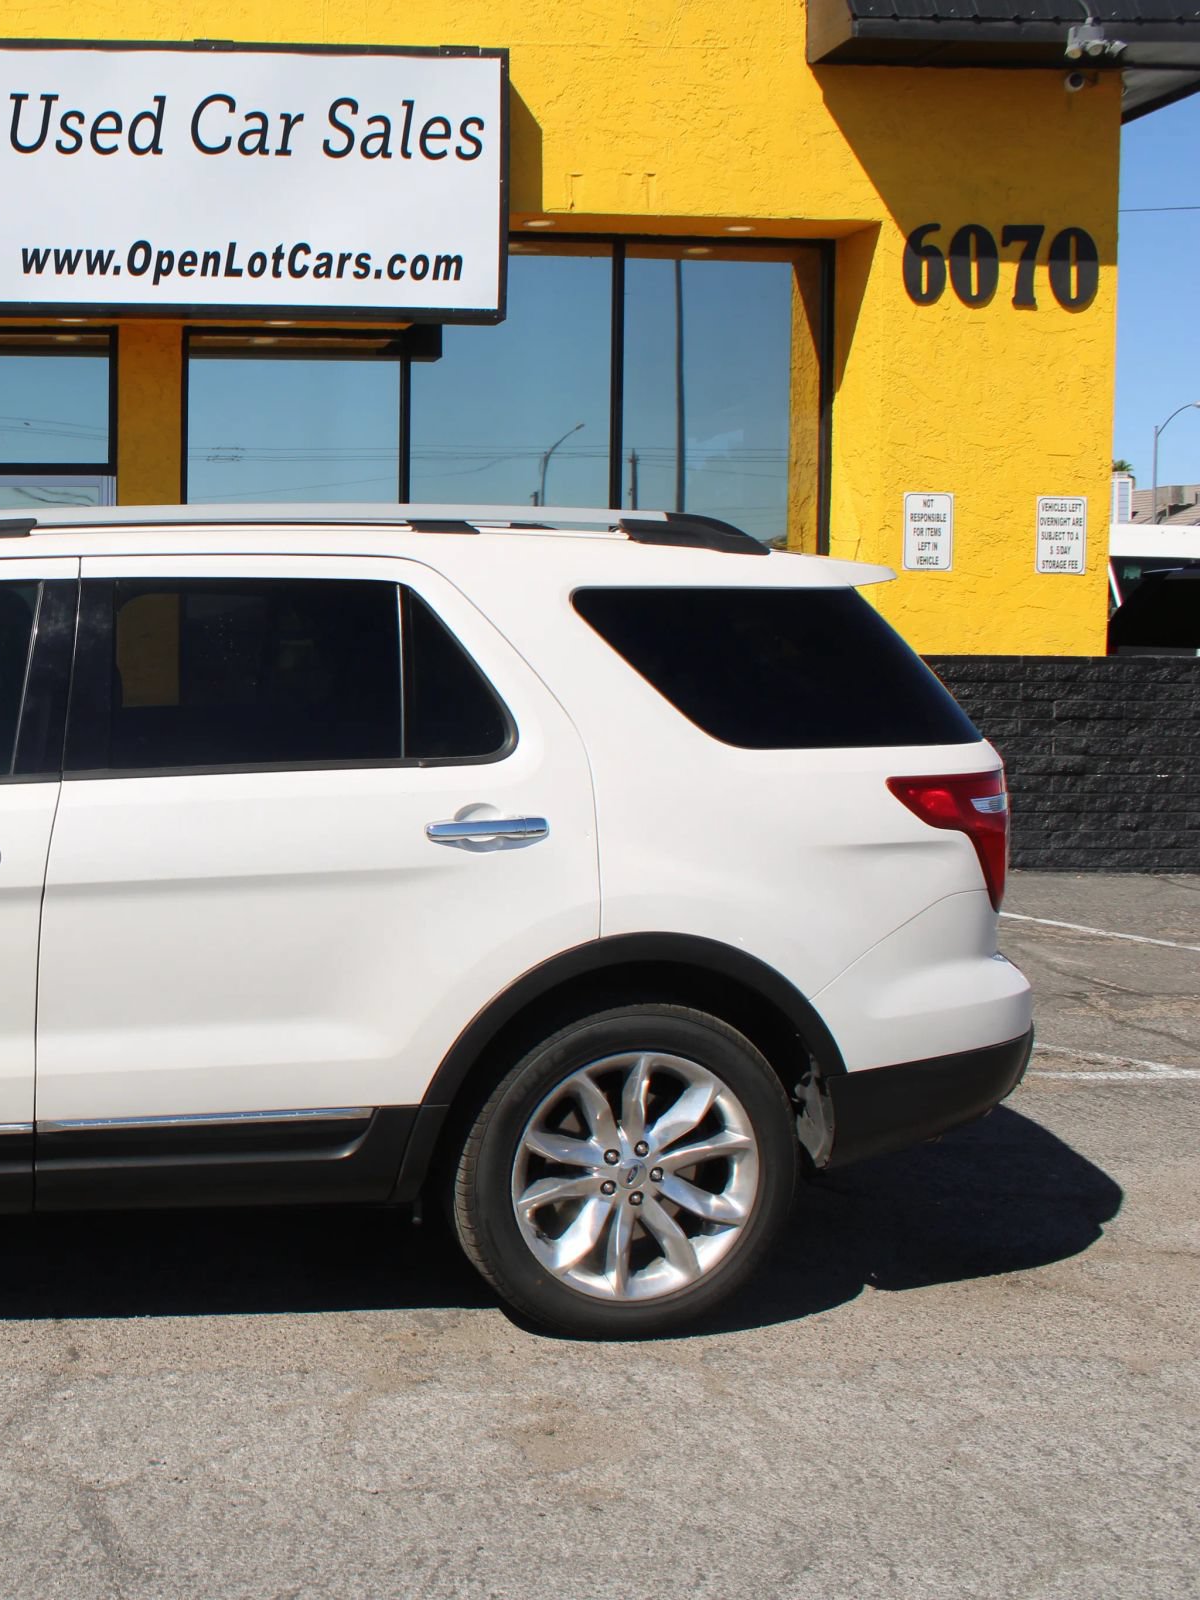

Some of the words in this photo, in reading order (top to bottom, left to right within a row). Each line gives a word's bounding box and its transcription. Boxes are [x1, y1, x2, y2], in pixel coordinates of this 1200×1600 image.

[8, 93, 167, 156] Used
[190, 93, 306, 157] Car
[322, 97, 486, 161] Sales
[20, 239, 464, 286] www.OpenLotCars.com
[902, 223, 1100, 312] 6070
[922, 499, 934, 509] NOT
[1041, 503, 1067, 513] VEHICLES
[1068, 503, 1082, 513] LEFT
[910, 513, 947, 523] RESPONSIBLE
[1040, 517, 1071, 527] OVERNIGHT
[1072, 517, 1083, 527] ARE
[913, 527, 924, 537] FOR
[925, 527, 942, 537] ITEMS
[1041, 532, 1065, 541] SUBJECT
[917, 542, 931, 551] LEFT
[916, 556, 939, 566] VEHICLE
[1042, 560, 1067, 570] STORAGE
[1068, 560, 1079, 570] FEE
